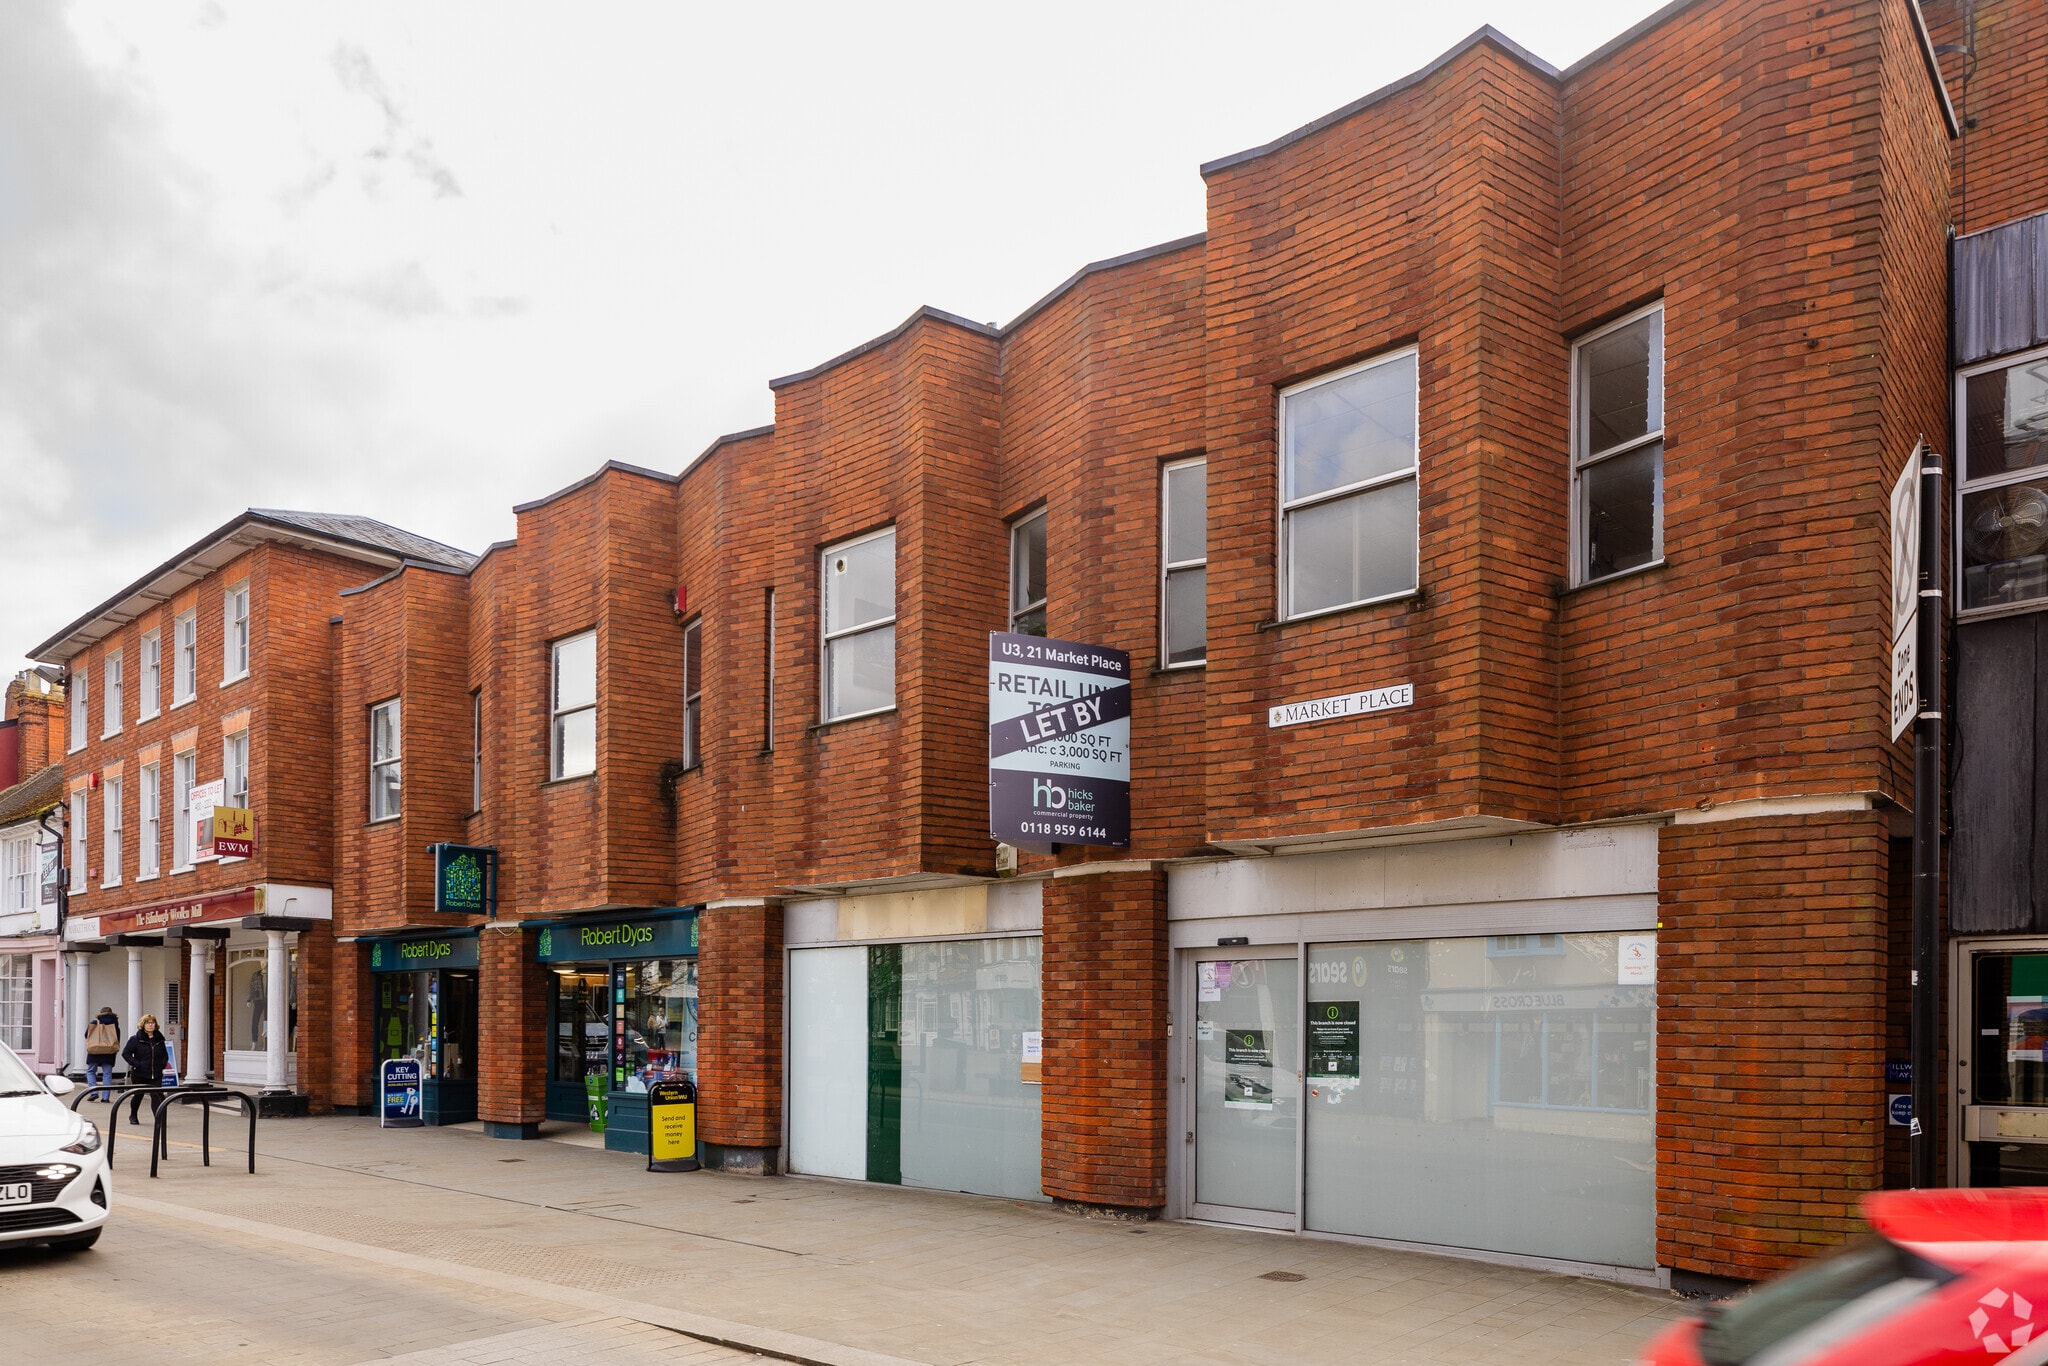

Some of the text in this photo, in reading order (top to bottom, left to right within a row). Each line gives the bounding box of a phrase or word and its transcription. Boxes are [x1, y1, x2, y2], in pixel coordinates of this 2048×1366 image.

[1002, 642, 1122, 671] U3, 21 Market Place
[1897, 643, 1910, 678] Zone
[998, 672, 1074, 699] RETAIL
[1285, 698, 1351, 722] MARKET
[1359, 688, 1409, 710] PLACE
[1894, 670, 1914, 725] ENDS
[1020, 696, 1102, 743] LET BY
[1080, 734, 1096, 747] SQ
[1098, 736, 1112, 748] FT
[1050, 746, 1057, 756] c
[1059, 745, 1090, 759] 3,000
[1092, 749, 1107, 763] SQ
[1110, 751, 1122, 763] FT
[1049, 760, 1081, 770] PARKING
[1033, 777, 1066, 809] hb
[1067, 787, 1094, 801] hicks
[1033, 809, 1094, 821] commercial property
[1067, 800, 1096, 813] baker
[1021, 821, 1107, 839] 0118 959 6144
[218, 842, 249, 853] EWM
[136, 904, 203, 926] The Edinburgh Woollen Mill
[581, 924, 653, 947] Robert Dyas
[401, 940, 451, 960] Robert Dyas
[387, 1096, 405, 1104] FREE
